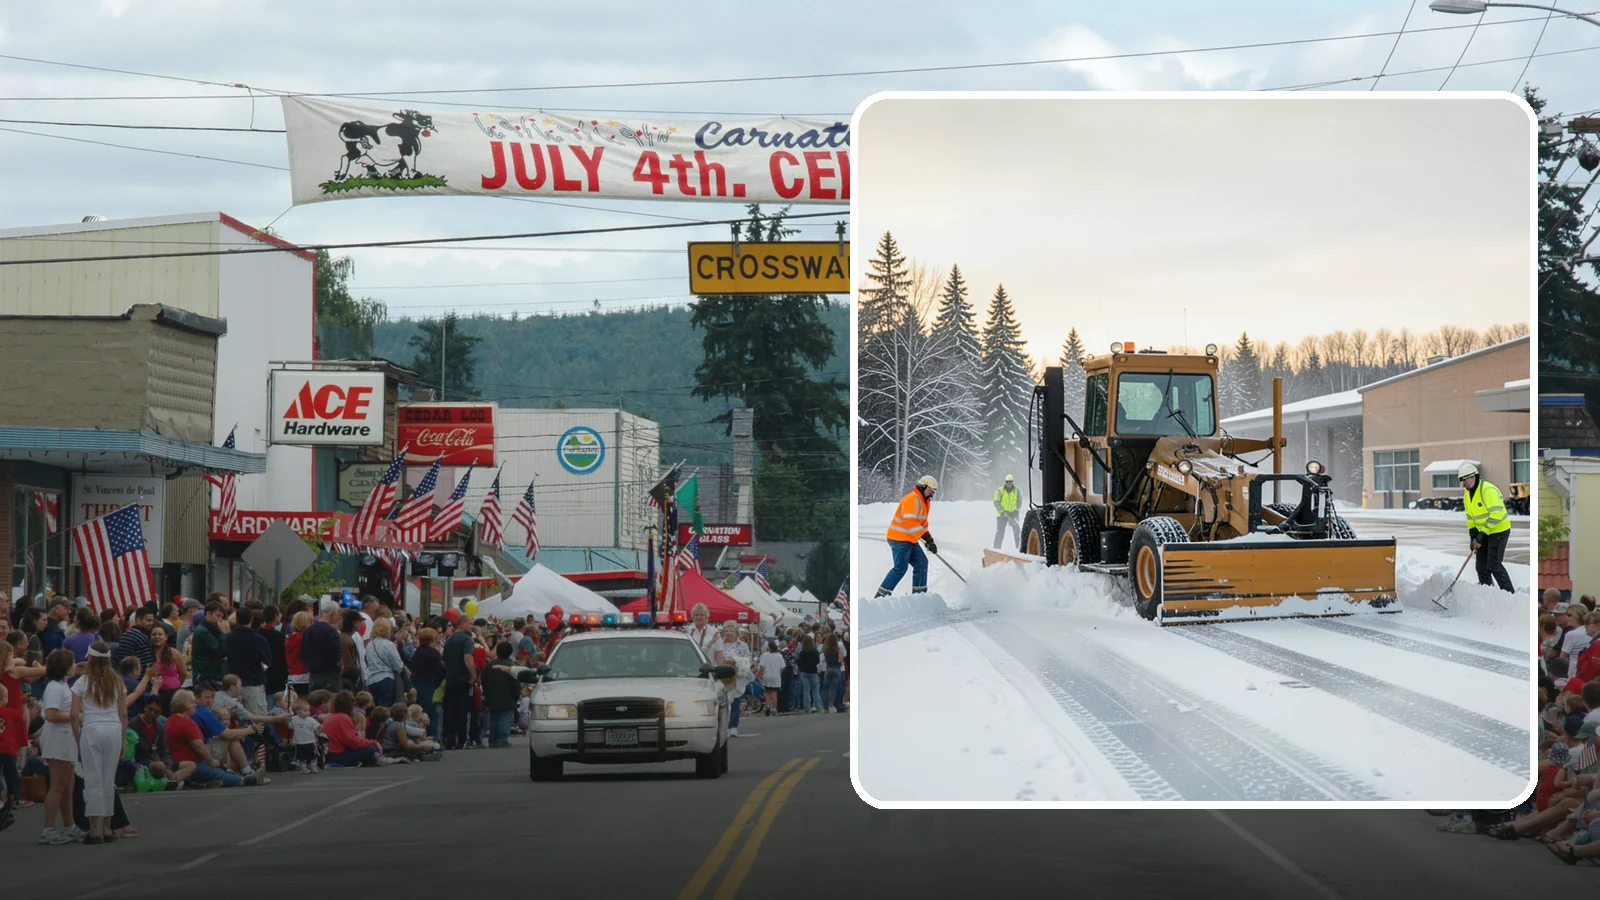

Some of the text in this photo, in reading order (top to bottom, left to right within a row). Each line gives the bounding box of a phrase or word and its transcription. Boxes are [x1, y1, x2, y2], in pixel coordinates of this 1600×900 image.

[695, 122, 850, 150] Carnat
[481, 141, 605, 192] JULY
[632, 150, 747, 198] 4th.
[697, 254, 850, 280] CROSSWA
[283, 380, 373, 420] ACE
[406, 409, 452, 421] CEDAR
[283, 421, 371, 437] Hardware
[96, 485, 123, 495] Vincent
[126, 486, 135, 494] de
[137, 486, 155, 495] Paul
[688, 526, 741, 535] CRNATION
[699, 535, 730, 543] GLASS
